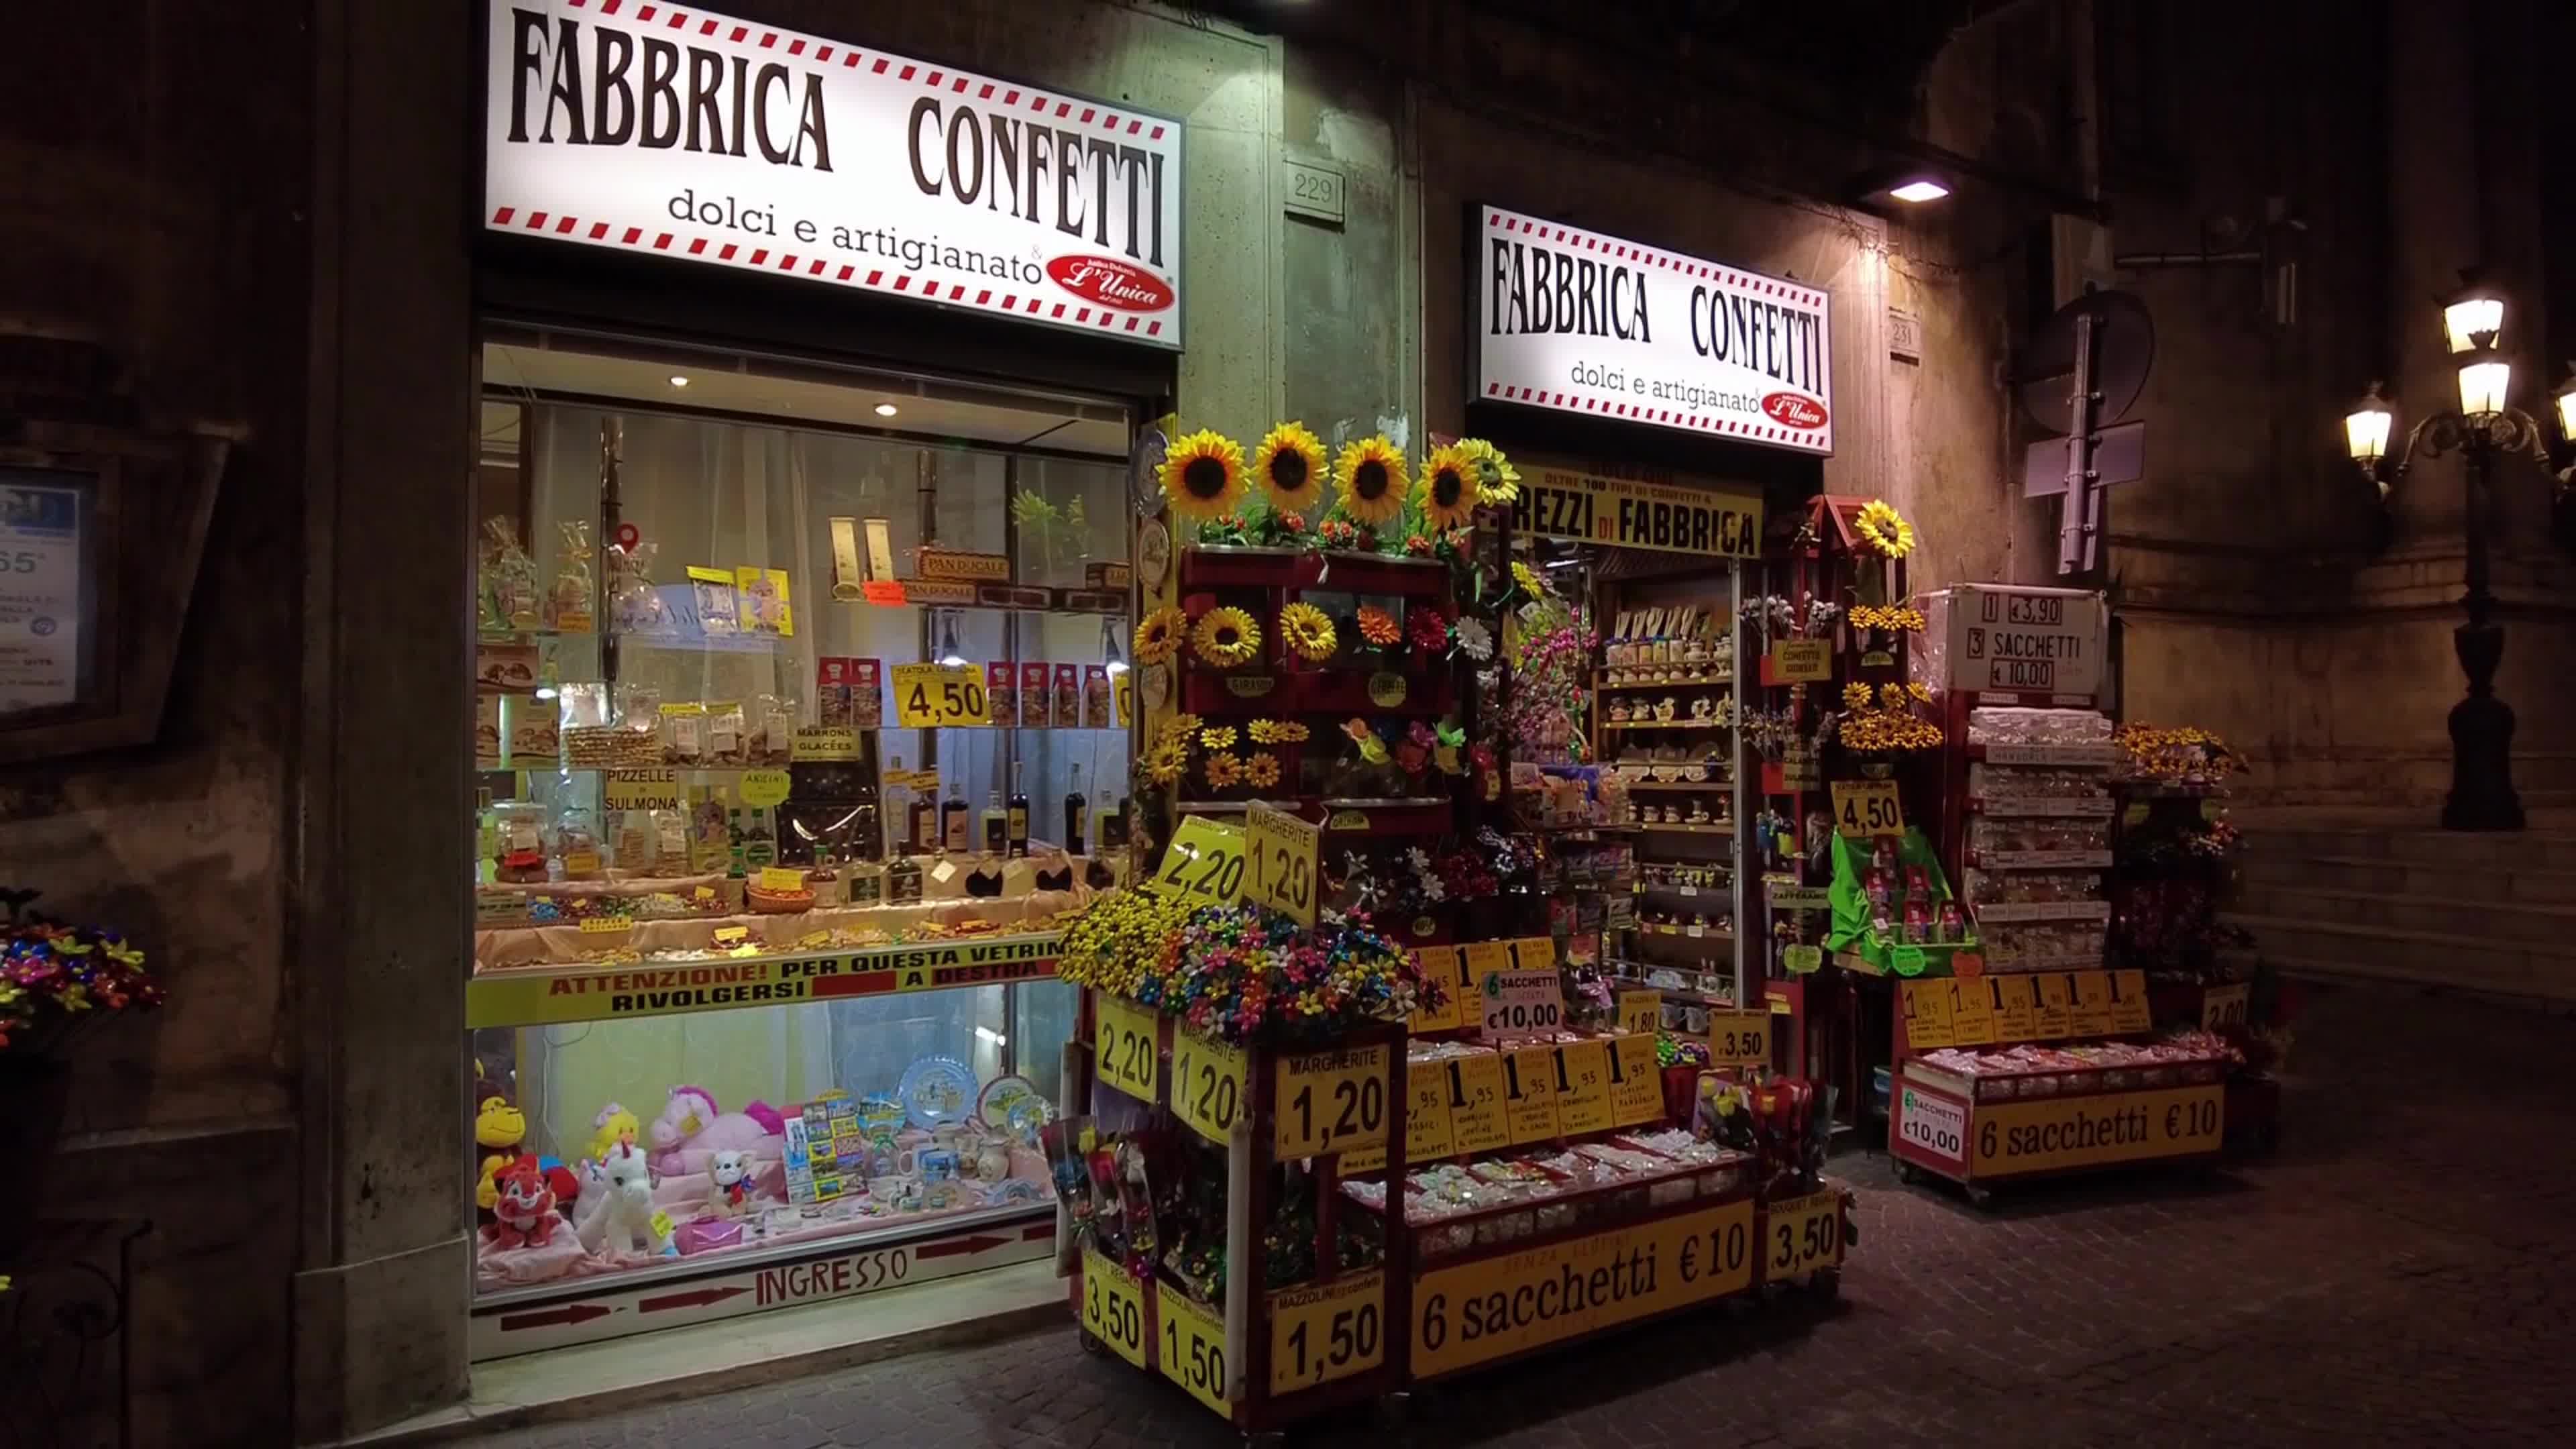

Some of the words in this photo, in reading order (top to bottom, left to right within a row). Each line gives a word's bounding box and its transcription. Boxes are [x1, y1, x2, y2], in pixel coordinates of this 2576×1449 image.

[508, 7, 833, 172] FABBRICA
[908, 97, 1164, 268] CONFETTI
[1295, 173, 1332, 203] 229
[668, 189, 777, 235] dolci
[794, 219, 817, 243] e
[833, 226, 1043, 285] artigianato
[1062, 262, 1159, 305] L'Unica
[1491, 237, 1651, 343] FABBRICA
[1690, 284, 1823, 397] CONFETTI
[1893, 323, 1912, 344] 231
[1571, 361, 1625, 391] dolci
[1633, 377, 1646, 394] e
[1652, 380, 1760, 414] artigianato
[1584, 478, 1607, 491] 100
[1491, 484, 1593, 537] REZZI
[1619, 498, 1755, 556] FABBRICA
[1972, 631, 1982, 655] 3
[1994, 633, 2080, 659] SACCHETTI
[908, 682, 983, 723] 4,50
[796, 728, 853, 738] MARRONS
[606, 769, 675, 782] PIZZELLE
[605, 797, 678, 810] SULMONA
[1250, 808, 1311, 847] MARGHERITE
[1843, 796, 1897, 836] 4,50
[1164, 842, 1245, 901] 2,20
[1252, 839, 1310, 910] 1,20
[549, 964, 767, 996] ATTENZIONE!
[782, 960, 839, 978] PER
[851, 949, 959, 972] QUESTA
[970, 942, 1068, 963] VETRIN
[612, 981, 804, 1012] RIVOLGERSI
[906, 972, 924, 986] A
[934, 961, 1038, 983] DESTRA
[1488, 972, 1499, 996] 6
[1501, 976, 1558, 988] SACCHETTI
[1488, 1004, 1558, 1032] €10,00
[1725, 1031, 1762, 1057] 3,50
[1102, 1022, 1152, 1087] 2,20
[1288, 1049, 1378, 1076] MARGHERITE
[1179, 1051, 1236, 1130] 1,20
[1293, 1076, 1383, 1150] 1,20
[1406, 1090, 1438, 1120] ,95
[1980, 1120, 1997, 1159] 6
[2006, 1106, 2148, 1157] sacchetti
[1776, 1214, 1834, 1273] 3,50
[756, 1249, 908, 1306] INGRESSO
[1422, 1293, 1446, 1351] 6
[1460, 1242, 1657, 1342] sacchetti
[1089, 1275, 1139, 1350] 3,50
[1167, 1318, 1225, 1400] 1,50
[1287, 1303, 1378, 1381] 1,50
